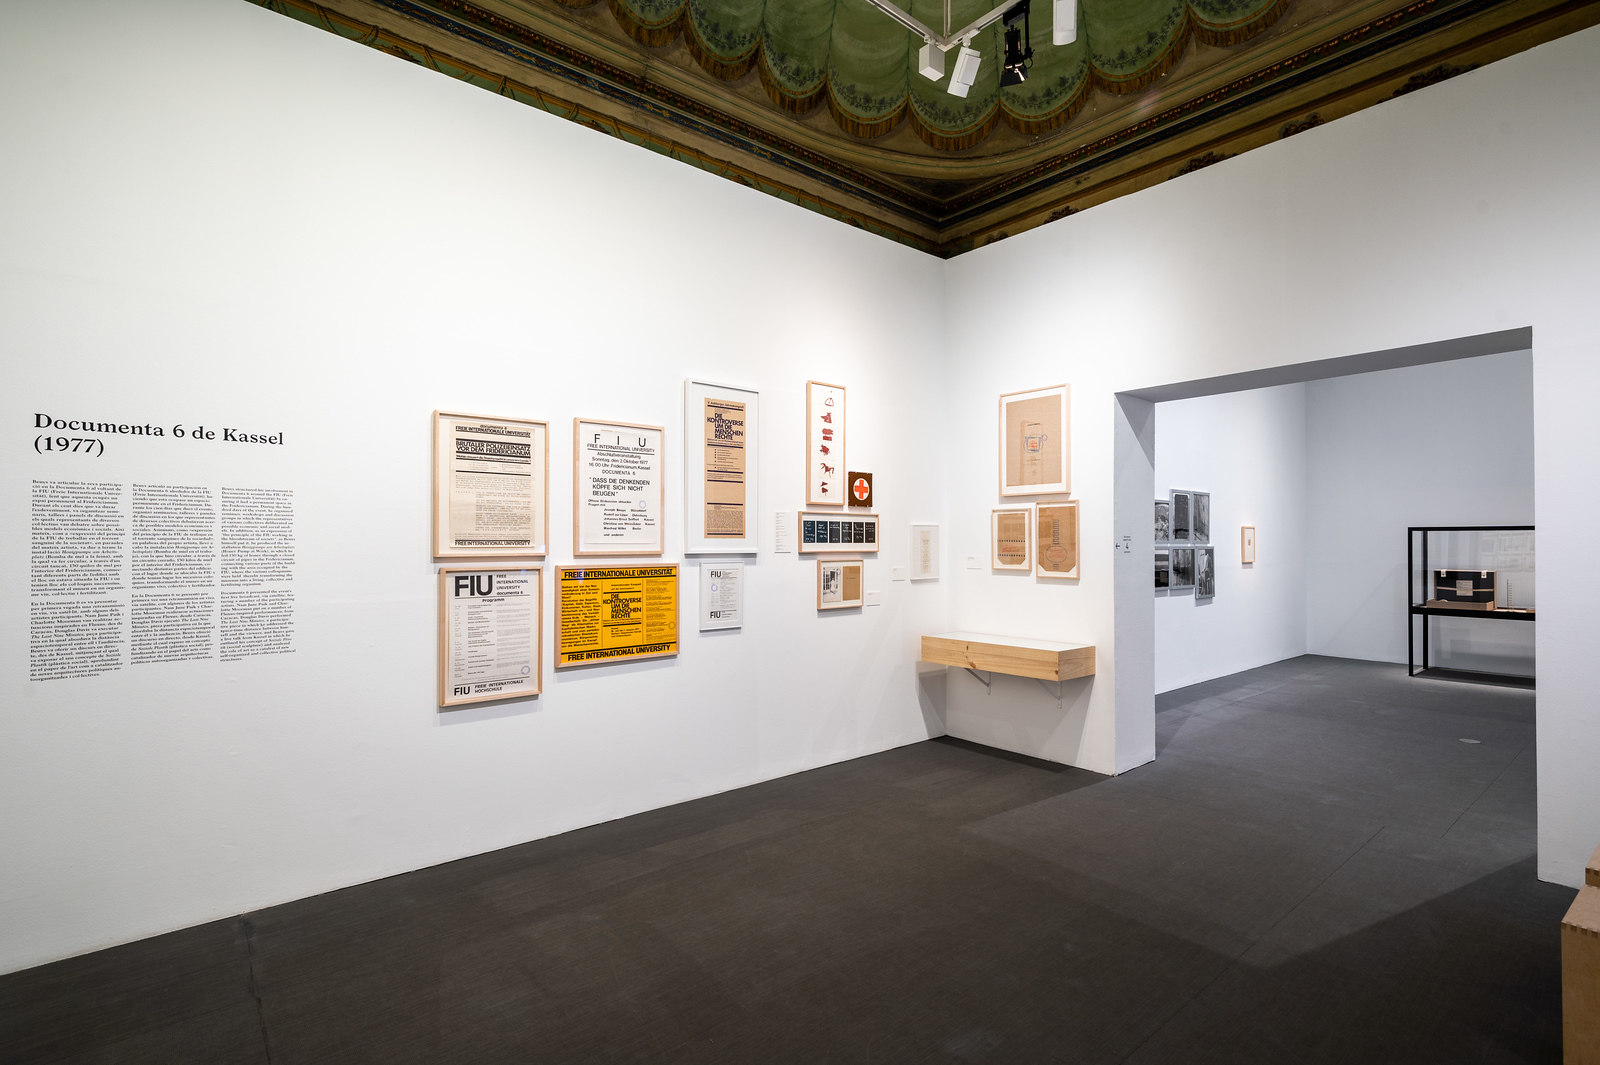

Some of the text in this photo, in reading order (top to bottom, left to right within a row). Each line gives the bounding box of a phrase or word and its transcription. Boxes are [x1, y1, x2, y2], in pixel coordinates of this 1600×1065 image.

[707, 417, 743, 426] KONTROVERSE
[34, 413, 284, 445] Documenta 6 de Kassel
[34, 435, 104, 457] (1977)
[595, 434, 646, 447] F I U
[455, 575, 492, 597] FIU
[586, 649, 634, 659] INTERNATIONAL
[636, 645, 670, 653] UNIVERSITY
[454, 686, 470, 696] FIU
